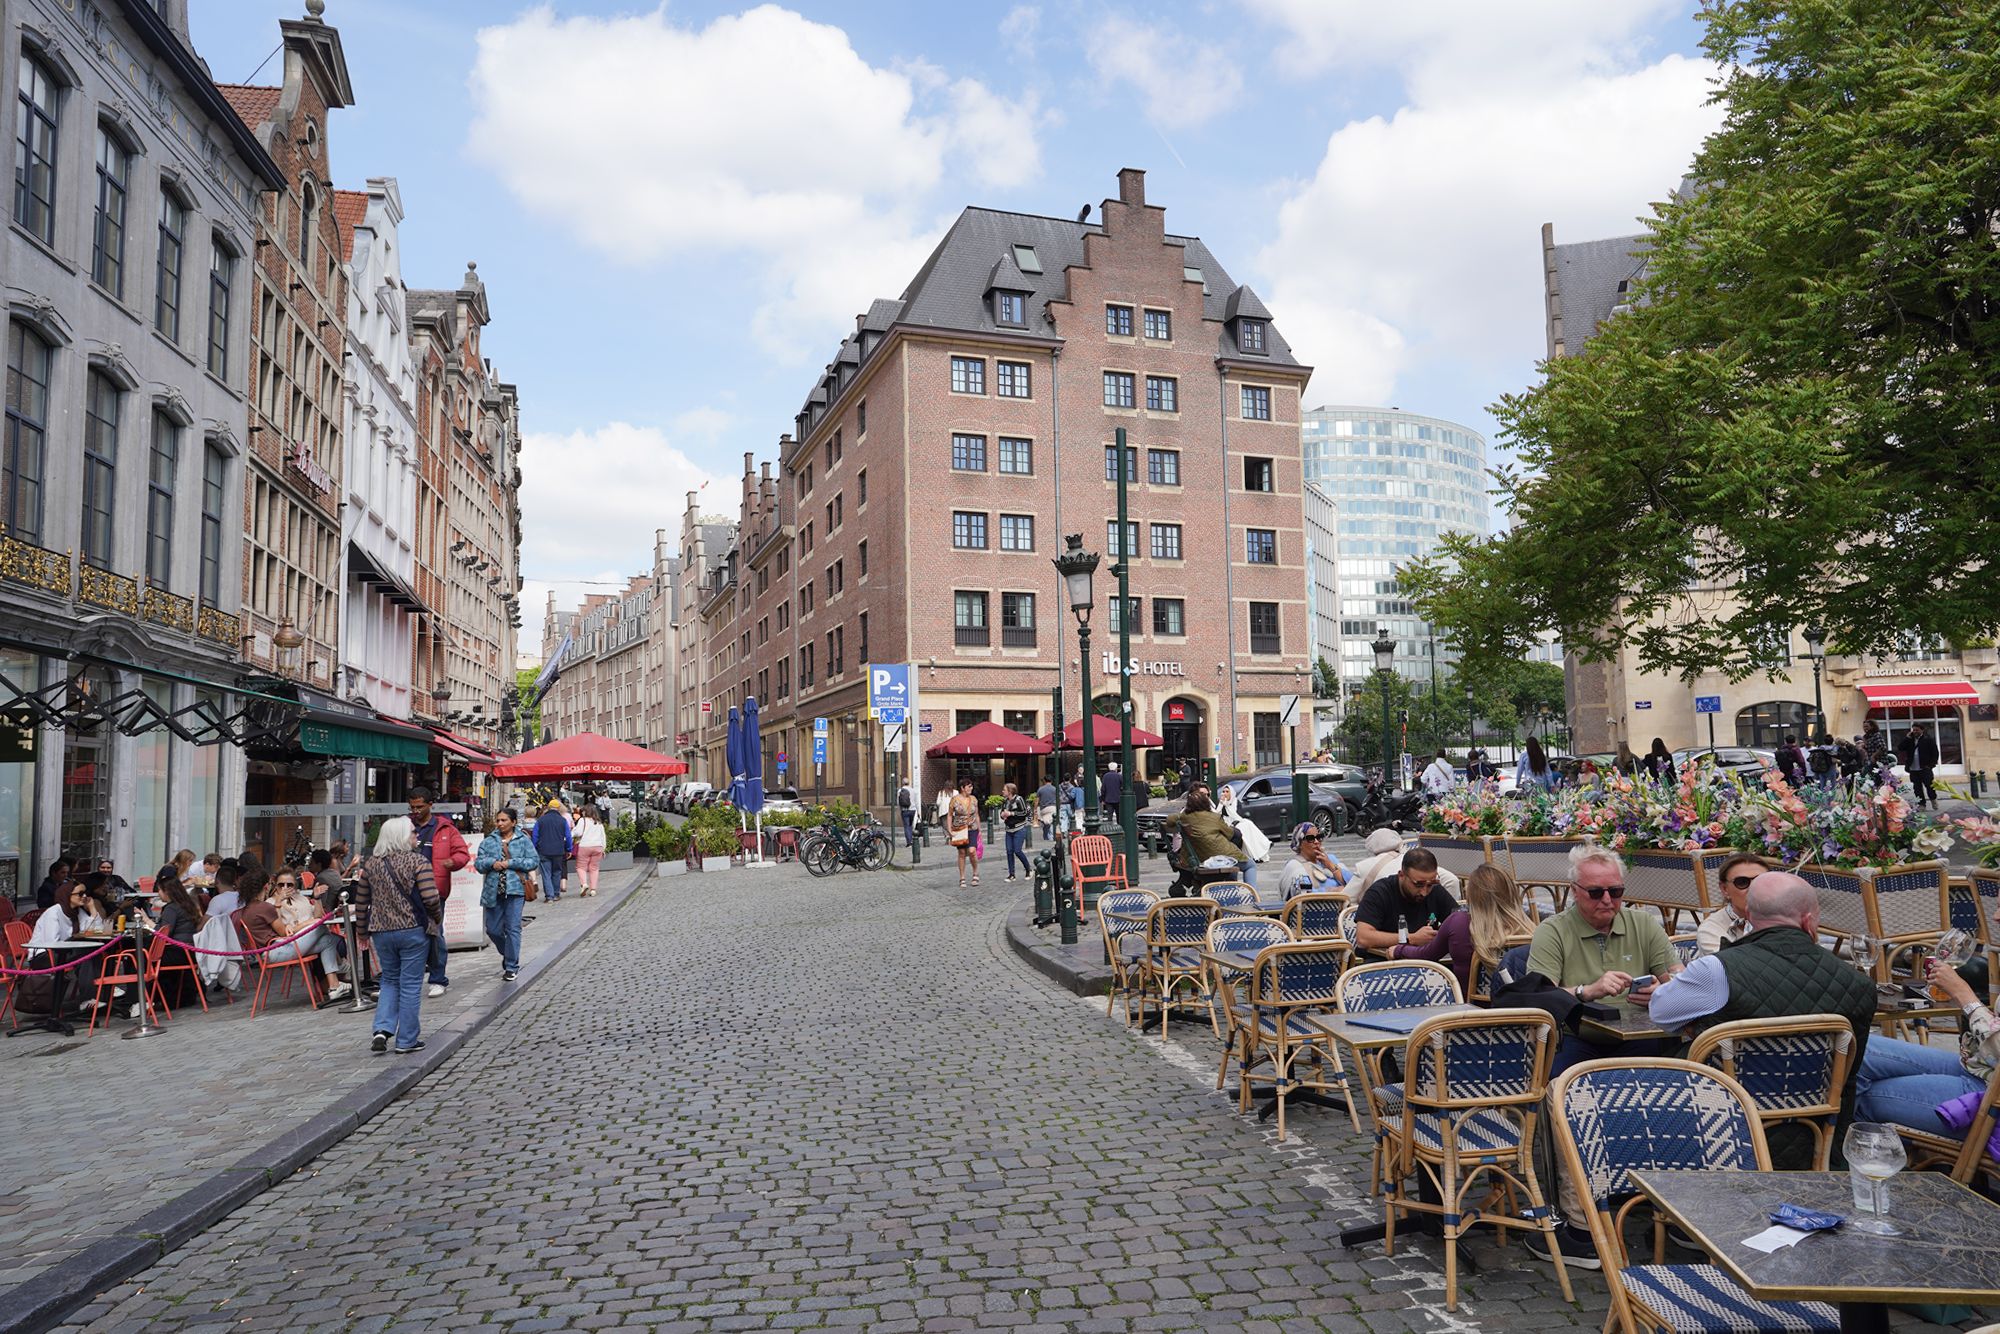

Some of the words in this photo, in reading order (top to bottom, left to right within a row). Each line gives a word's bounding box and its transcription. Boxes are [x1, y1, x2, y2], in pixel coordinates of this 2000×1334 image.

[1102, 651, 1140, 674] ibs
[1143, 661, 1185, 676] HOTEL
[1865, 668, 1901, 677] BELGIAN
[1902, 665, 1958, 676] CHOCOLATES
[873, 670, 891, 695] P
[817, 739, 824, 749] P
[562, 764, 591, 774] pasta
